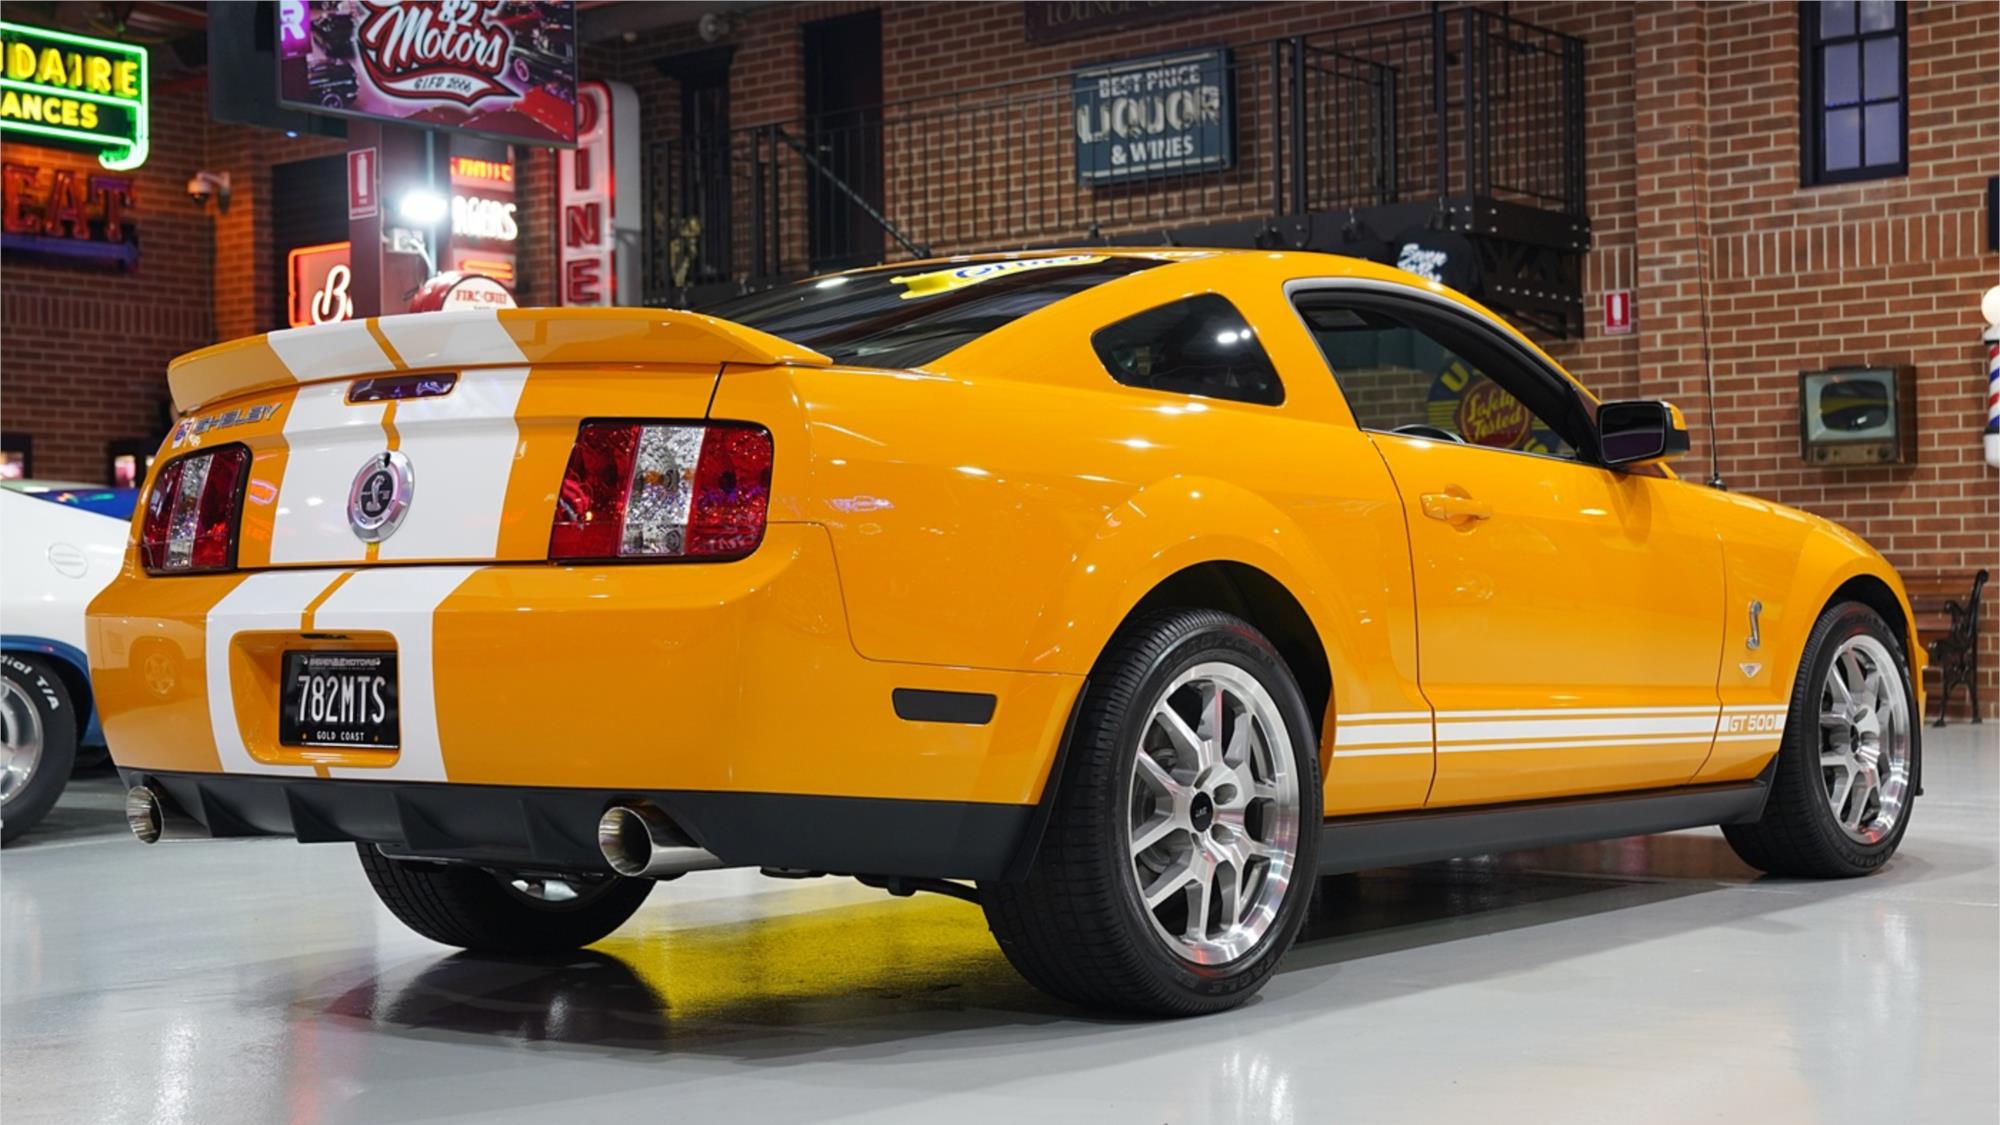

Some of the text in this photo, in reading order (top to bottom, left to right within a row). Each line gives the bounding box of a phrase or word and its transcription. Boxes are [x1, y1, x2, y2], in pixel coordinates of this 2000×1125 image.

[365, 5, 503, 69] Motors
[1099, 64, 1200, 98] BEST PRICE
[0, 90, 99, 129] ANCES
[1111, 135, 1194, 165] & WINES
[2, 163, 135, 243] EAT
[1473, 406, 1522, 442] Tested
[37, 676, 59, 710] T/A
[298, 676, 386, 724] 782MTS
[316, 731, 364, 741] GOLD COAST
[1730, 714, 1776, 731] GT 500
